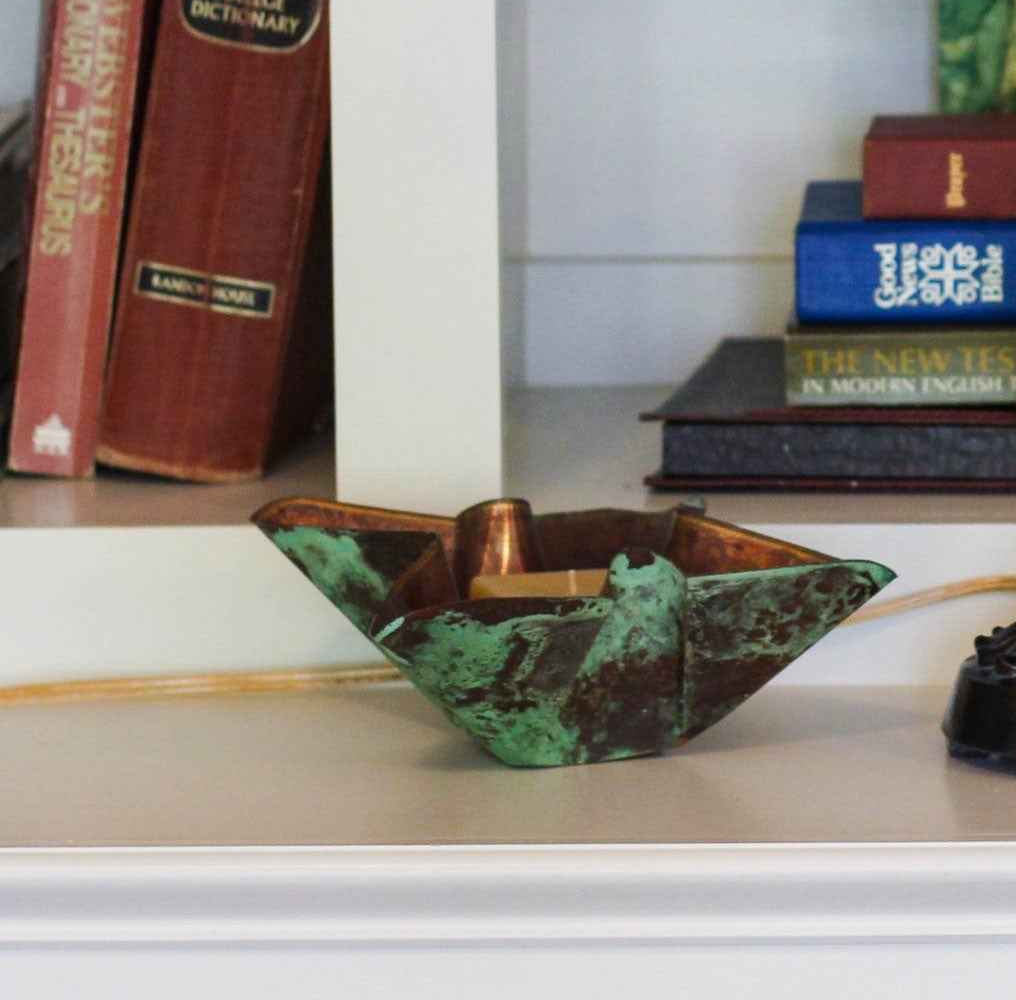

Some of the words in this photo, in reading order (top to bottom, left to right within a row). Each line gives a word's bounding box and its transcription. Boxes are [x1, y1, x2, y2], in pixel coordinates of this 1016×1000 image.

[40, 107, 87, 258] THESAURUS
[874, 243, 896, 309] Good
[896, 242, 918, 307] News
[981, 243, 1003, 302] Bible
[801, 344, 866, 376] THE
[873, 344, 951, 376] NEW
[802, 377, 825, 393] IN
[829, 376, 917, 393] MODERN
[921, 375, 1003, 393] ENGLISH
